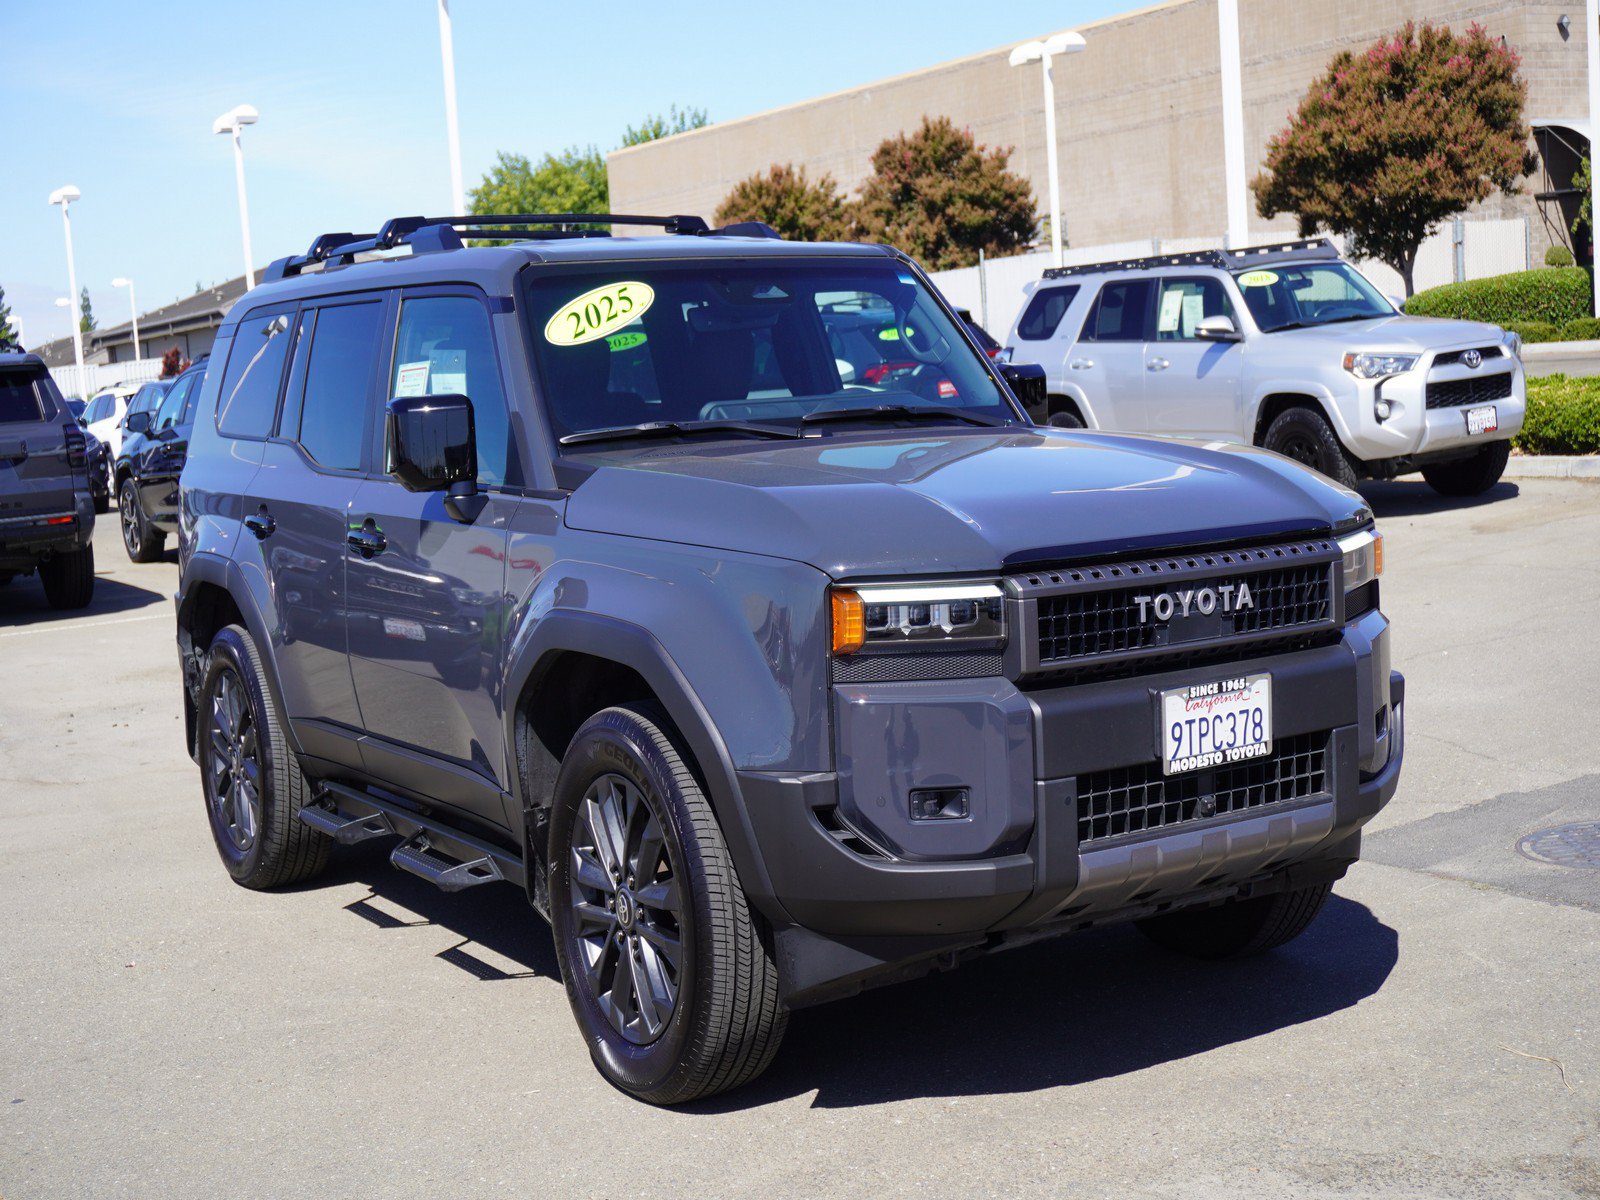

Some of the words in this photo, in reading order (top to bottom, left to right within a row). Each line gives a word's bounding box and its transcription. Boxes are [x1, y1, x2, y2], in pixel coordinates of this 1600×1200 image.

[566, 287, 633, 339] 2025
[1134, 583, 1254, 623] TOYOTA
[1185, 691, 1250, 713] California
[1190, 685, 1219, 698] SINCE
[1222, 679, 1246, 692] 1965
[1171, 707, 1263, 760] 9TPC378
[1170, 752, 1223, 773] MODESTO
[1226, 743, 1267, 762] TOYOTA
